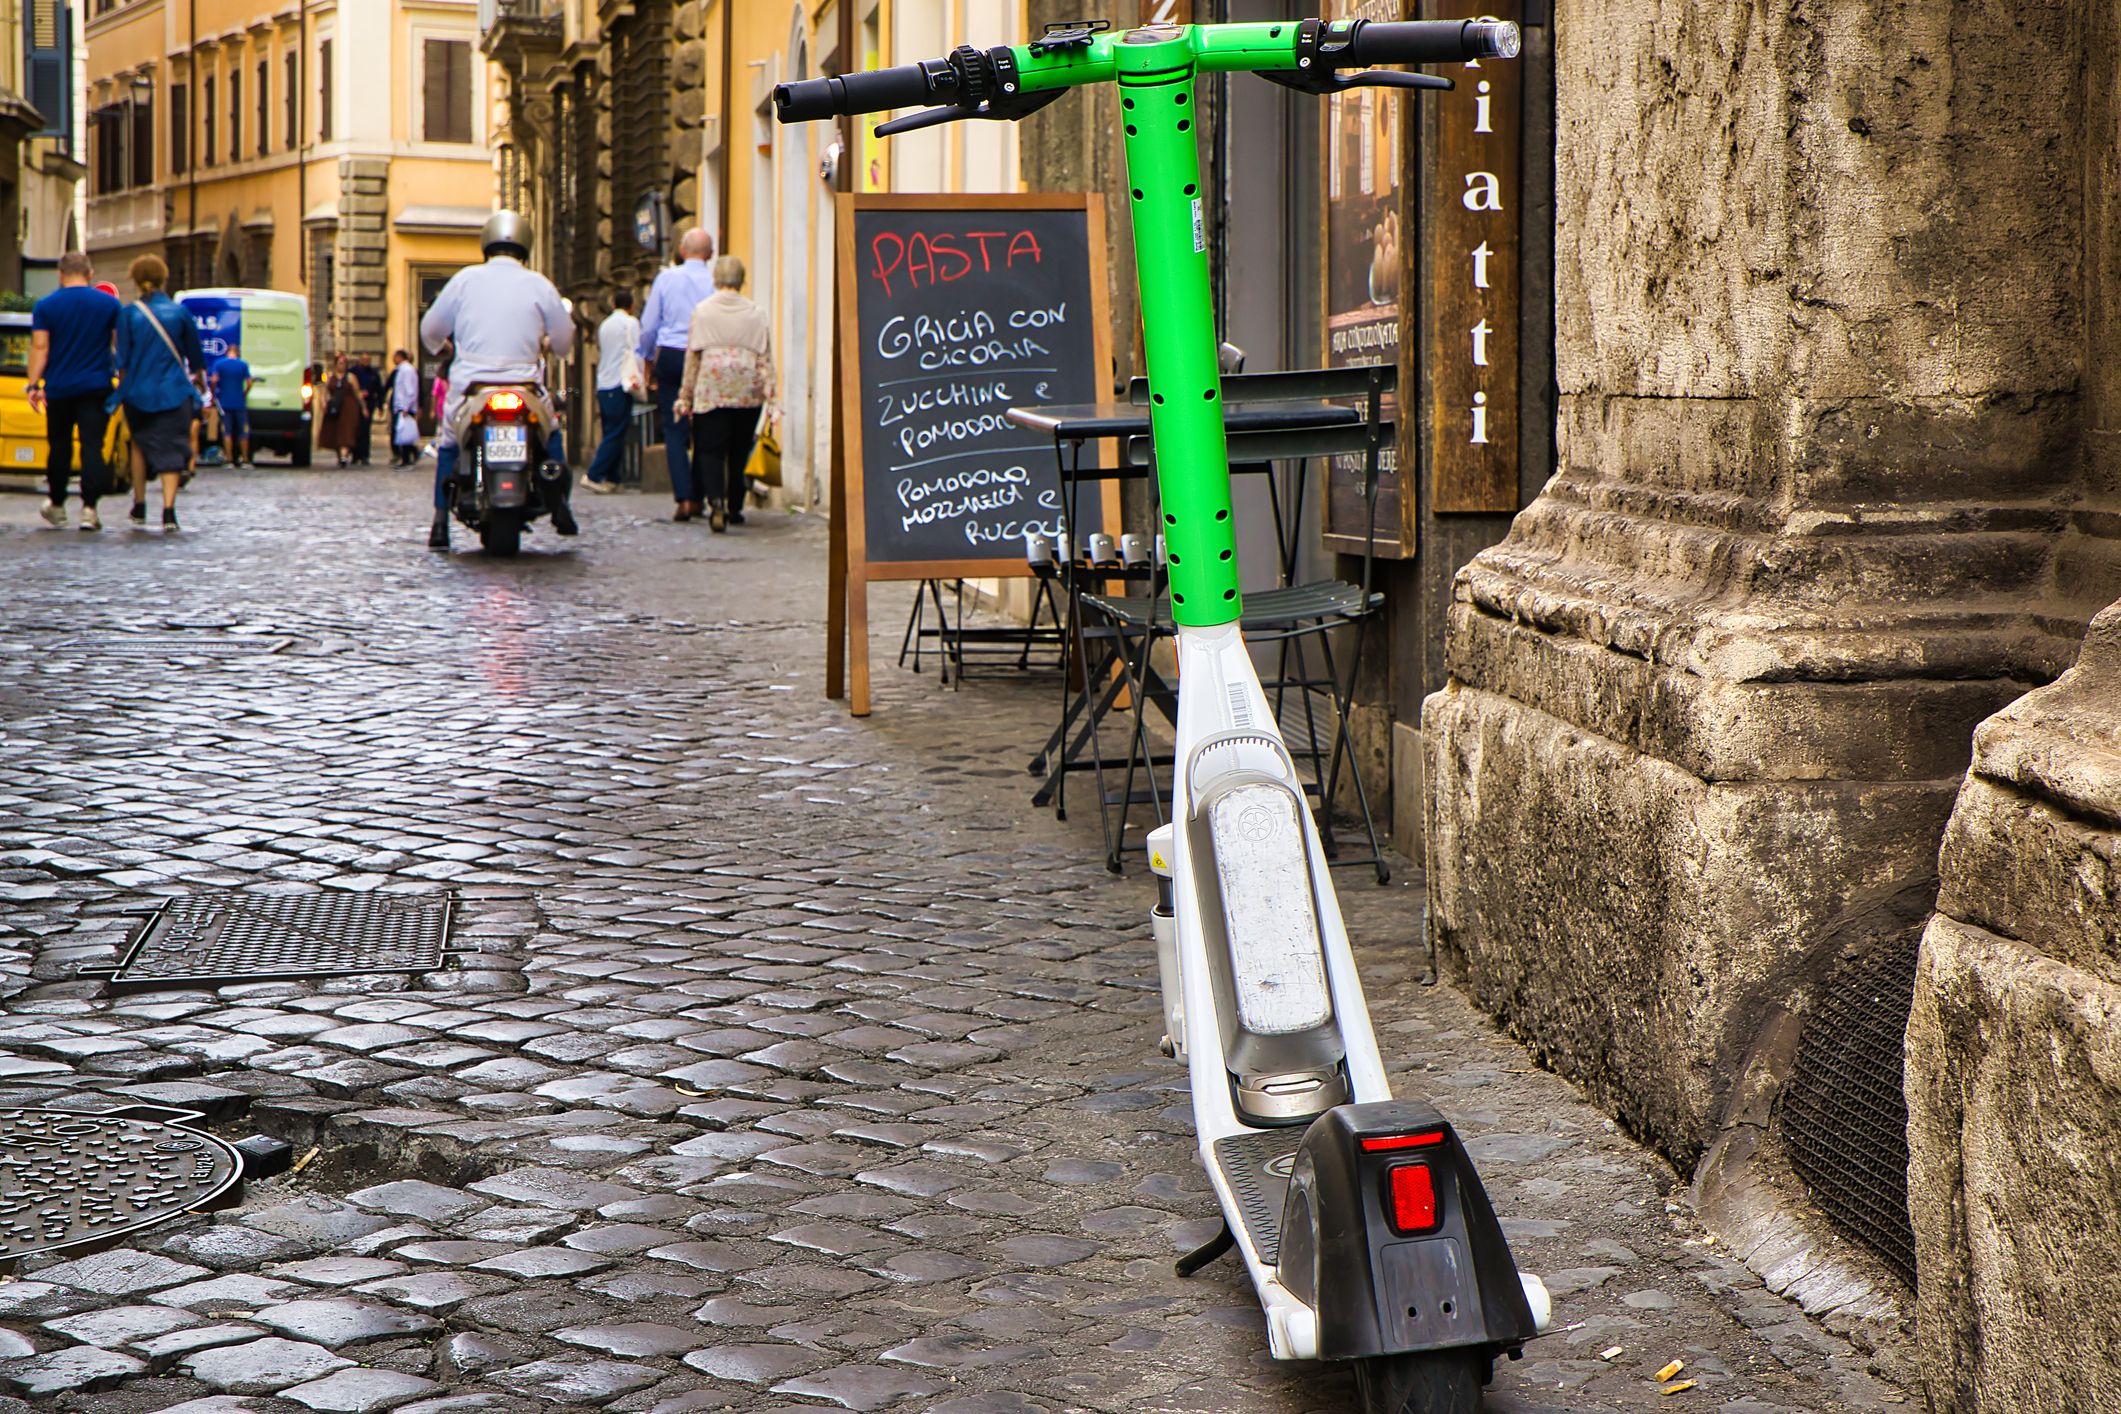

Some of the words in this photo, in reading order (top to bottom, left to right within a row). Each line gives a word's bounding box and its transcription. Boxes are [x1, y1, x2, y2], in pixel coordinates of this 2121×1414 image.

[1462, 15, 1503, 444] iatti
[872, 230, 1041, 298] PASTA
[1008, 302, 1066, 328] CON
[900, 413, 1017, 458] POMODOR
